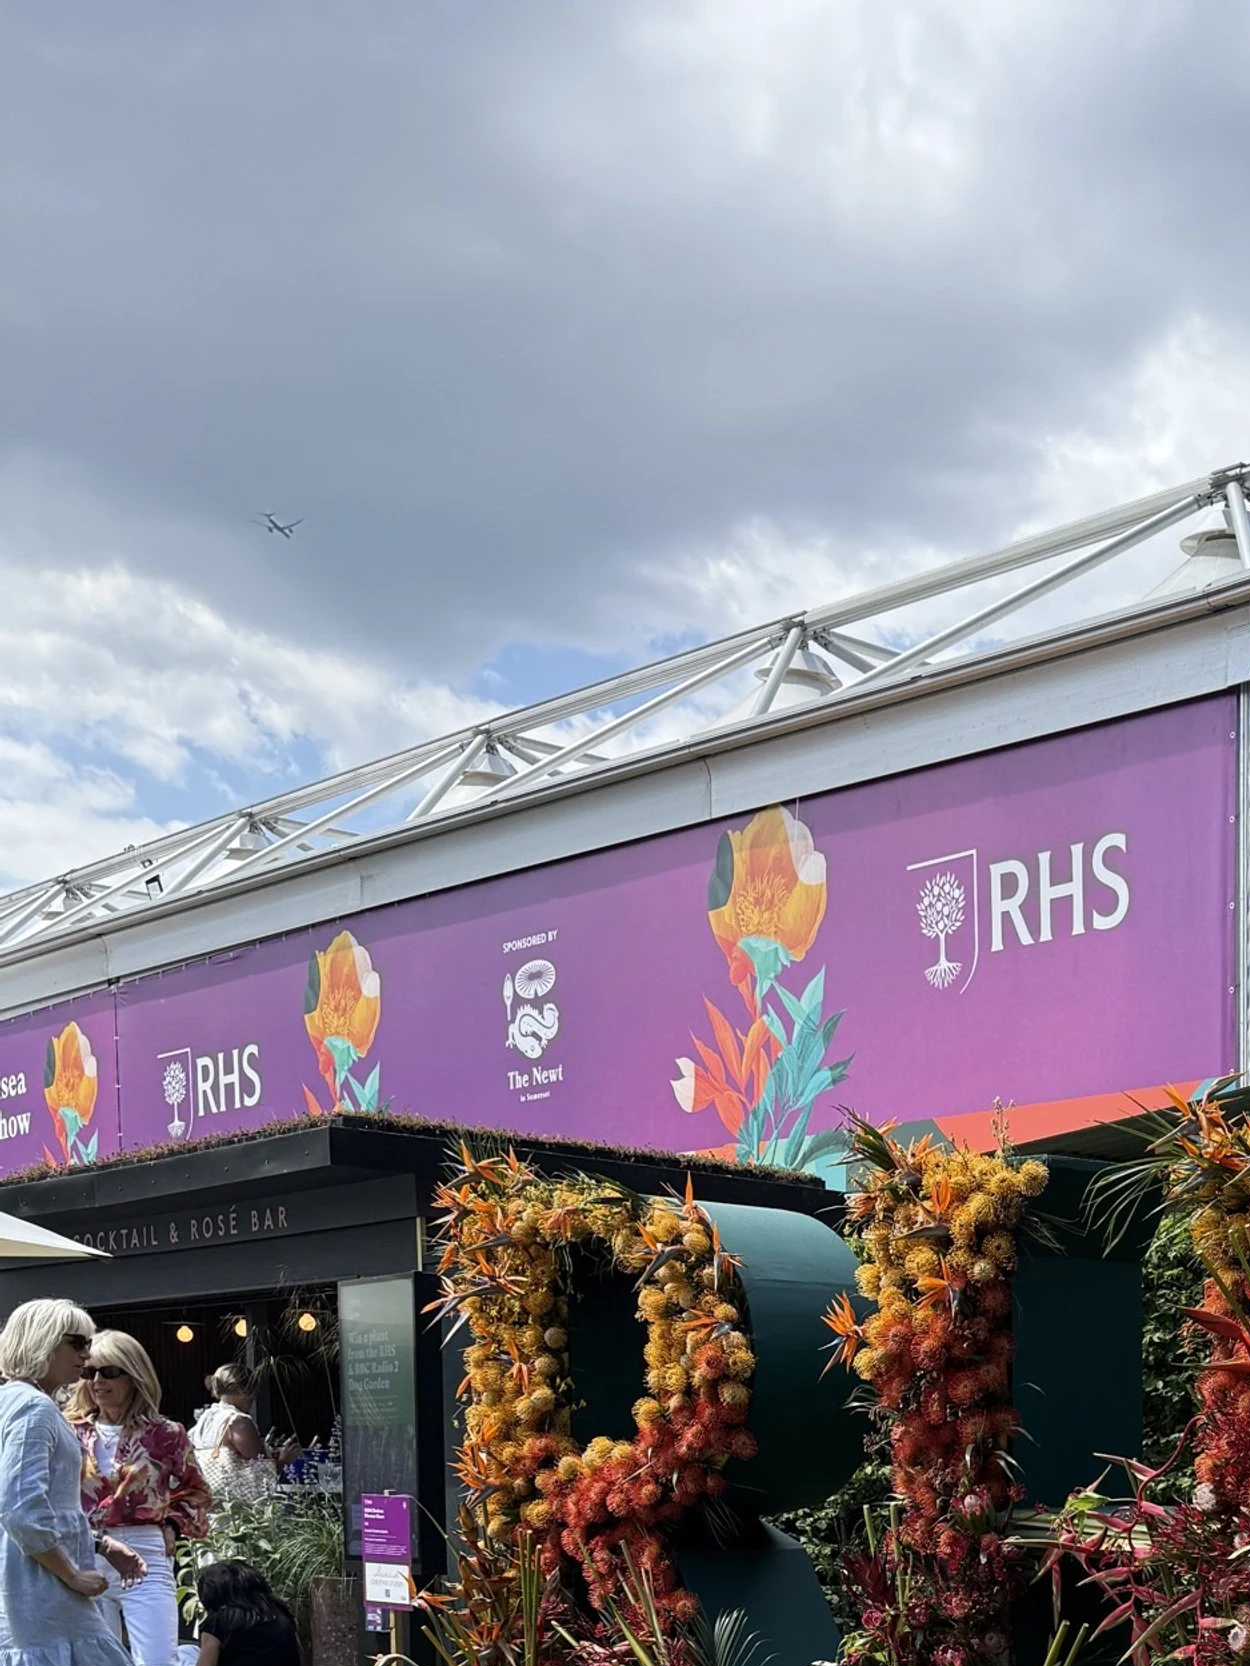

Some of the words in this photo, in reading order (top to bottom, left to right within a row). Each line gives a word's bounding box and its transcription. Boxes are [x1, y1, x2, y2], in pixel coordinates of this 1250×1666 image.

[989, 832, 1131, 952] RHS
[502, 932, 547, 954] SPONSORED
[547, 929, 558, 942] BY
[195, 1043, 261, 1117] RHS
[507, 1070, 530, 1090] The
[532, 1063, 563, 1086] Newt
[169, 1221, 179, 1244] &
[190, 1205, 238, 1240] ROSÉ
[251, 1206, 288, 1232] BAR
[368, 1329, 389, 1346] plant
[348, 1347, 365, 1360] from
[366, 1347, 378, 1358] the
[379, 1344, 396, 1357] RHS
[355, 1362, 370, 1374] BBC
[371, 1360, 393, 1373] Radio
[394, 1360, 399, 1373] 2
[363, 1377, 390, 1390] Garden
